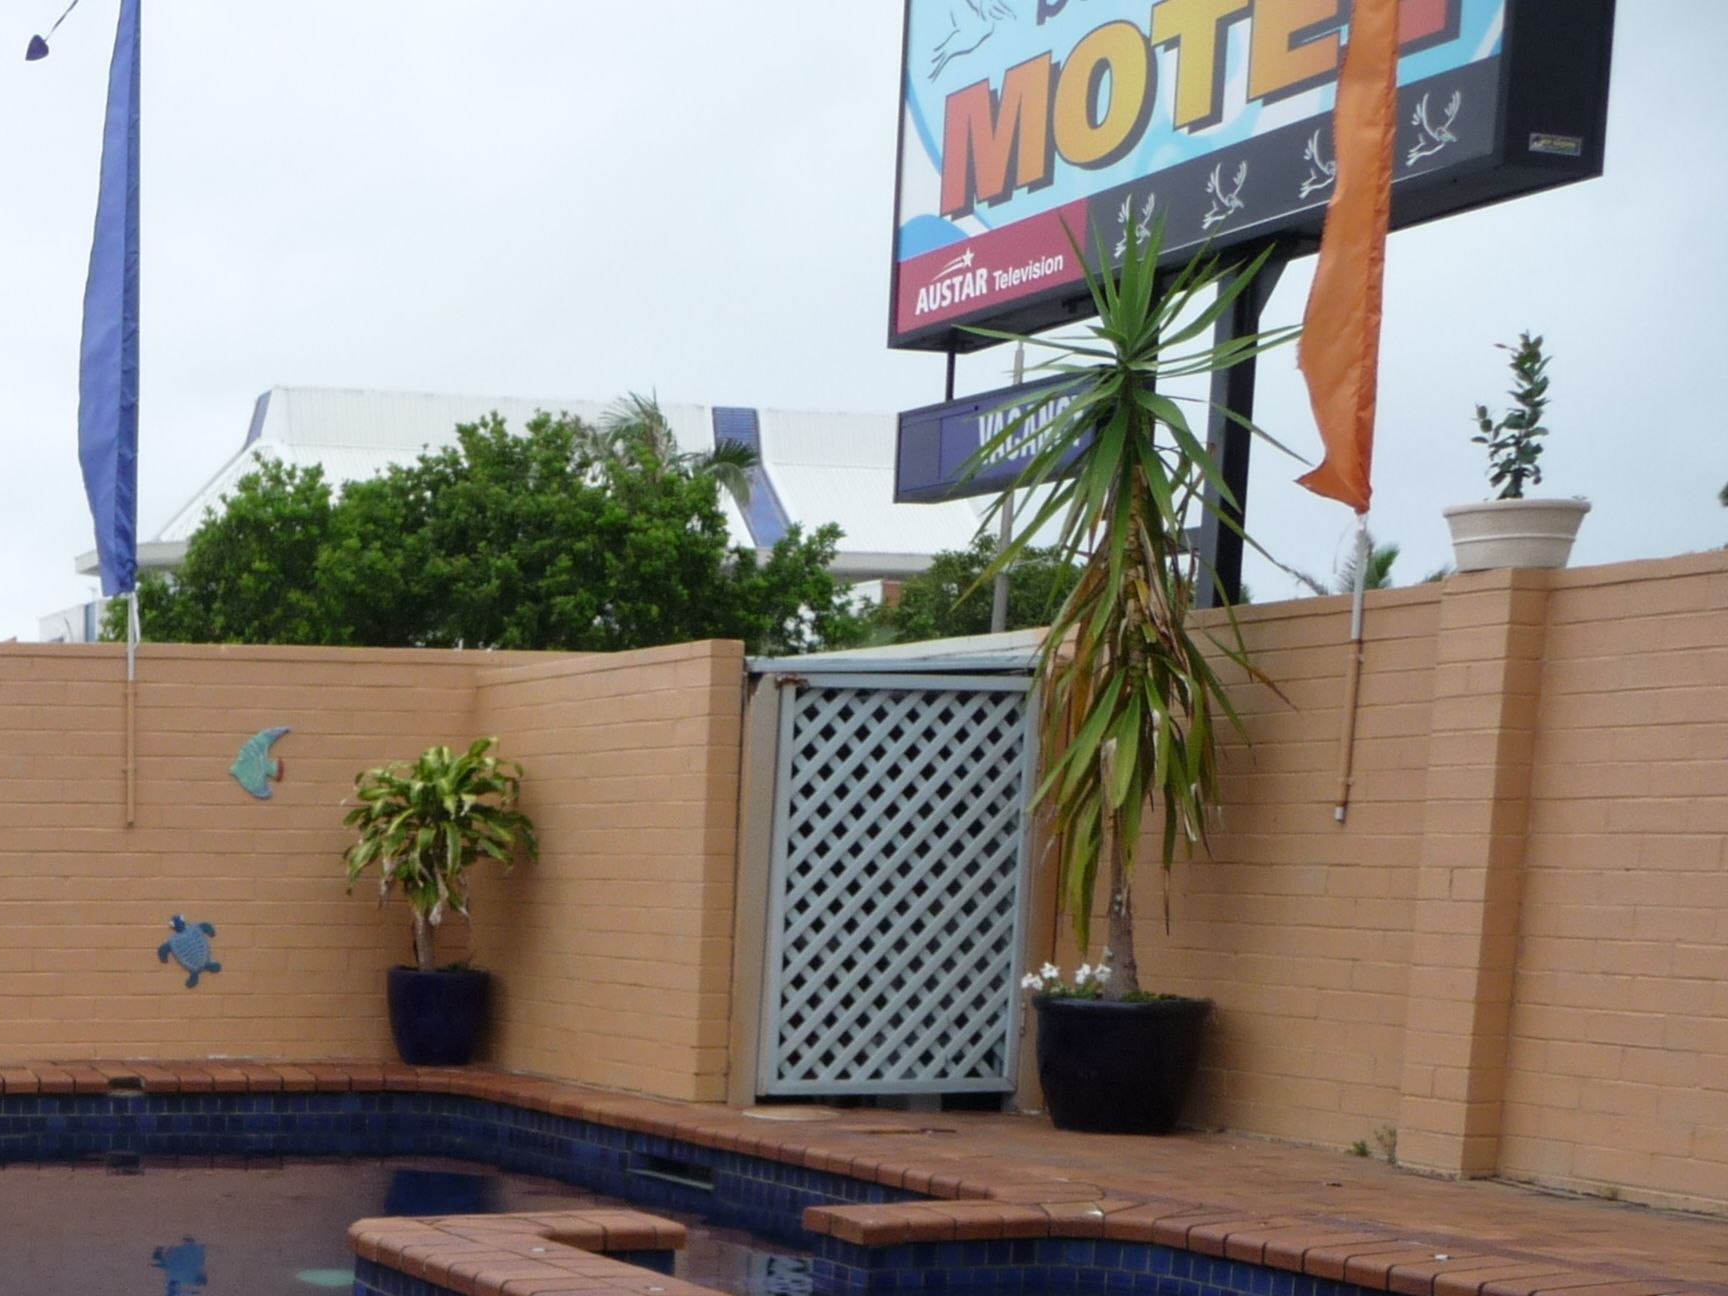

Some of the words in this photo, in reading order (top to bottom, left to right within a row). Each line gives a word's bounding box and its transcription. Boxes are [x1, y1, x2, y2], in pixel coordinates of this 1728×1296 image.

[939, 0, 1449, 219] MOTE
[915, 267, 988, 316] AUSTAR
[992, 253, 1064, 291] Television
